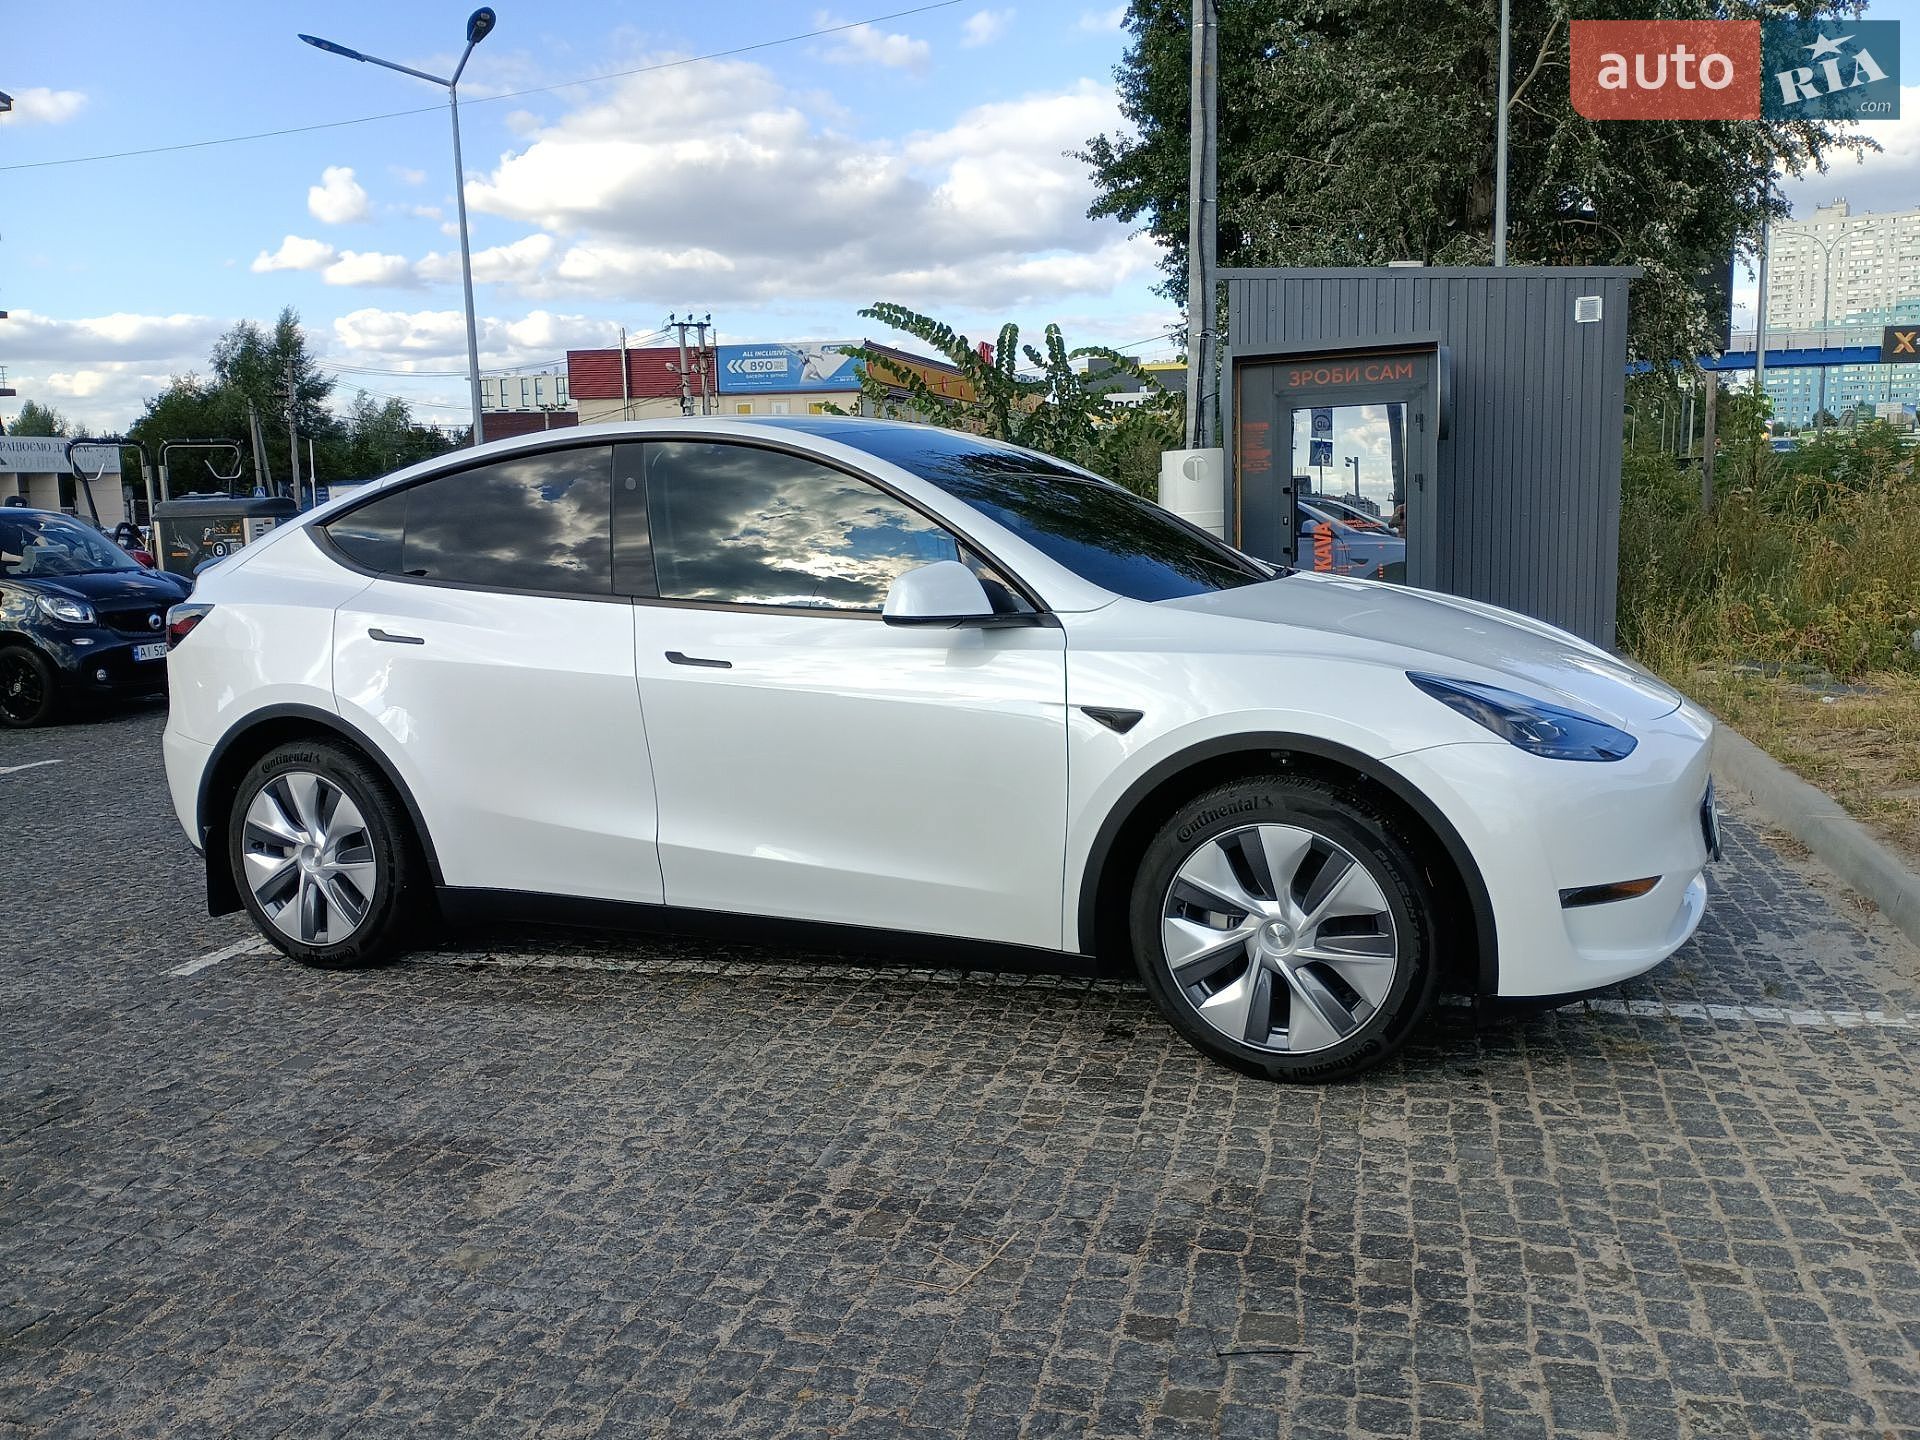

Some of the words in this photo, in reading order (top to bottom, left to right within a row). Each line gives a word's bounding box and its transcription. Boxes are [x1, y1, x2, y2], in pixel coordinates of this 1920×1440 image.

[750, 361, 773, 371] 890
[1289, 367, 1360, 387] ЗРОБИ
[1365, 362, 1413, 382] САМ
[216, 545, 224, 555] 8
[1313, 521, 1332, 573] KAVA
[262, 751, 313, 773] Continental
[1177, 795, 1258, 842] Continental
